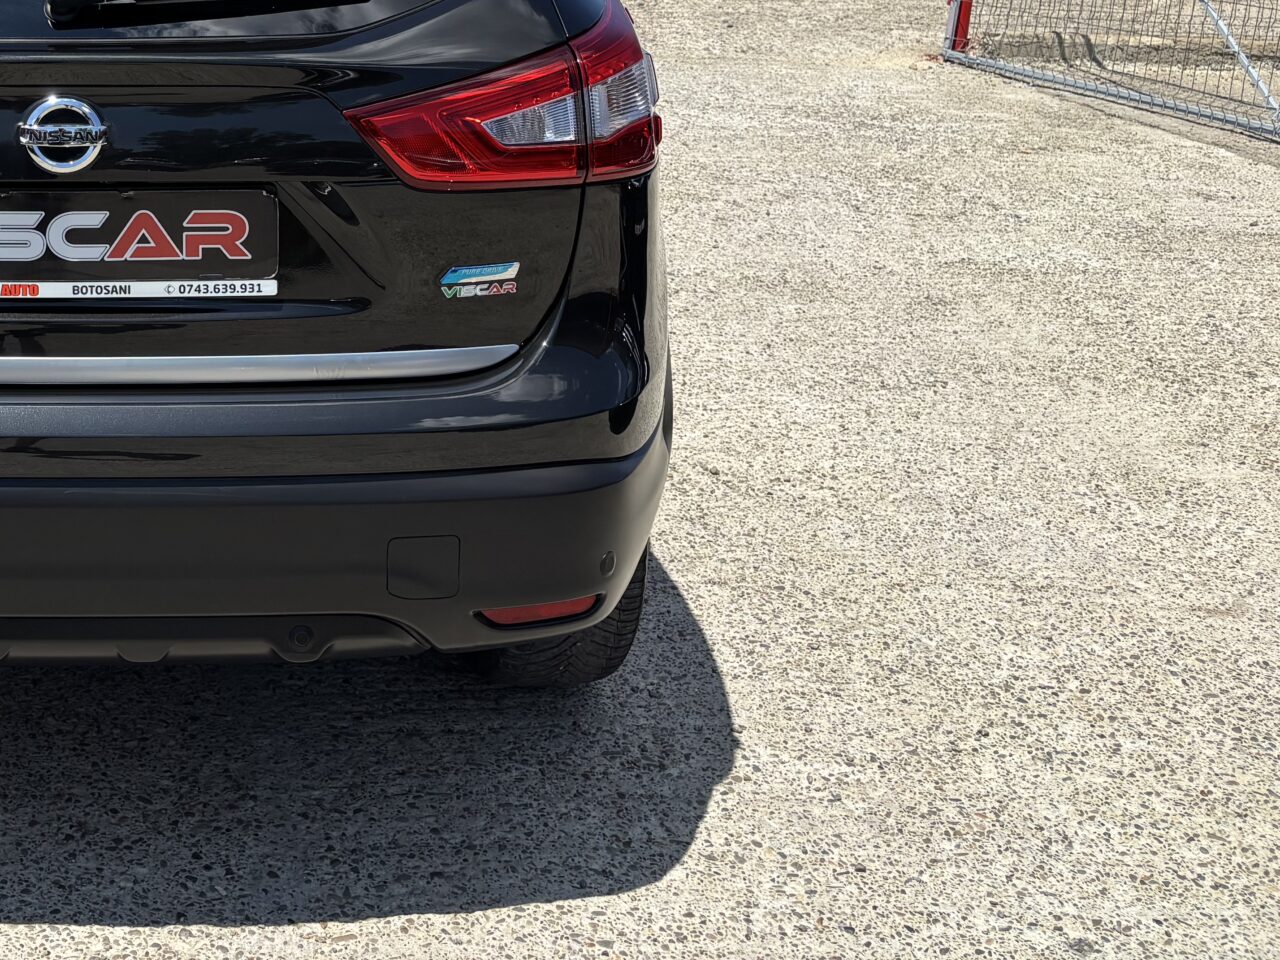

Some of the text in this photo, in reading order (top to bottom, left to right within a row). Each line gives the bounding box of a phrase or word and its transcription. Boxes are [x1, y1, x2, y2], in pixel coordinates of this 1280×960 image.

[29, 129, 98, 145] NISSAN
[0, 283, 40, 297] AUTO
[71, 284, 132, 295] BOTOSANI
[178, 283, 264, 295] 0743.639.931
[441, 281, 517, 299] VISCAR
